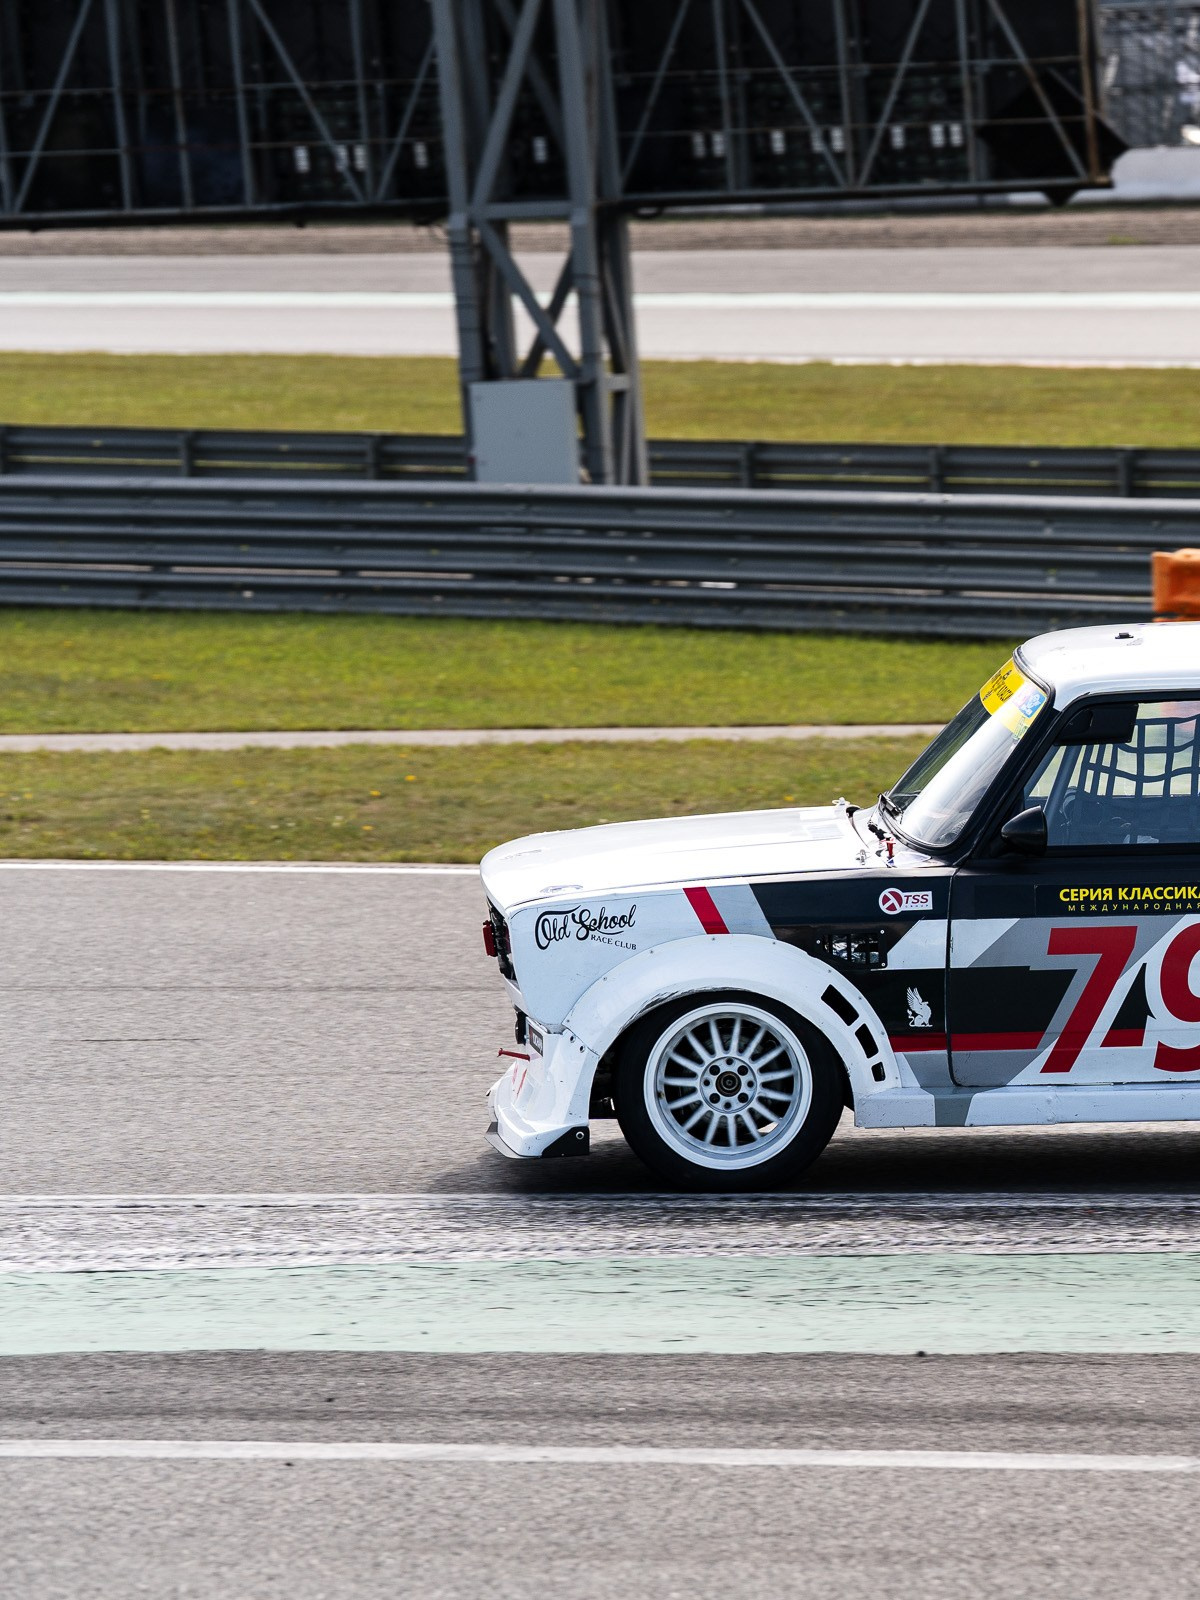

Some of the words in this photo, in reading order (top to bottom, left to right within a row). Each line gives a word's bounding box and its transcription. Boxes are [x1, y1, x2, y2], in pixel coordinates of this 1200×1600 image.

[904, 894, 929, 904] TSS
[1059, 888, 1113, 902] СЕРИЯ
[535, 905, 581, 950] Old
[571, 904, 637, 941] School
[590, 934, 613, 945] RACE
[614, 939, 637, 951] CLUB
